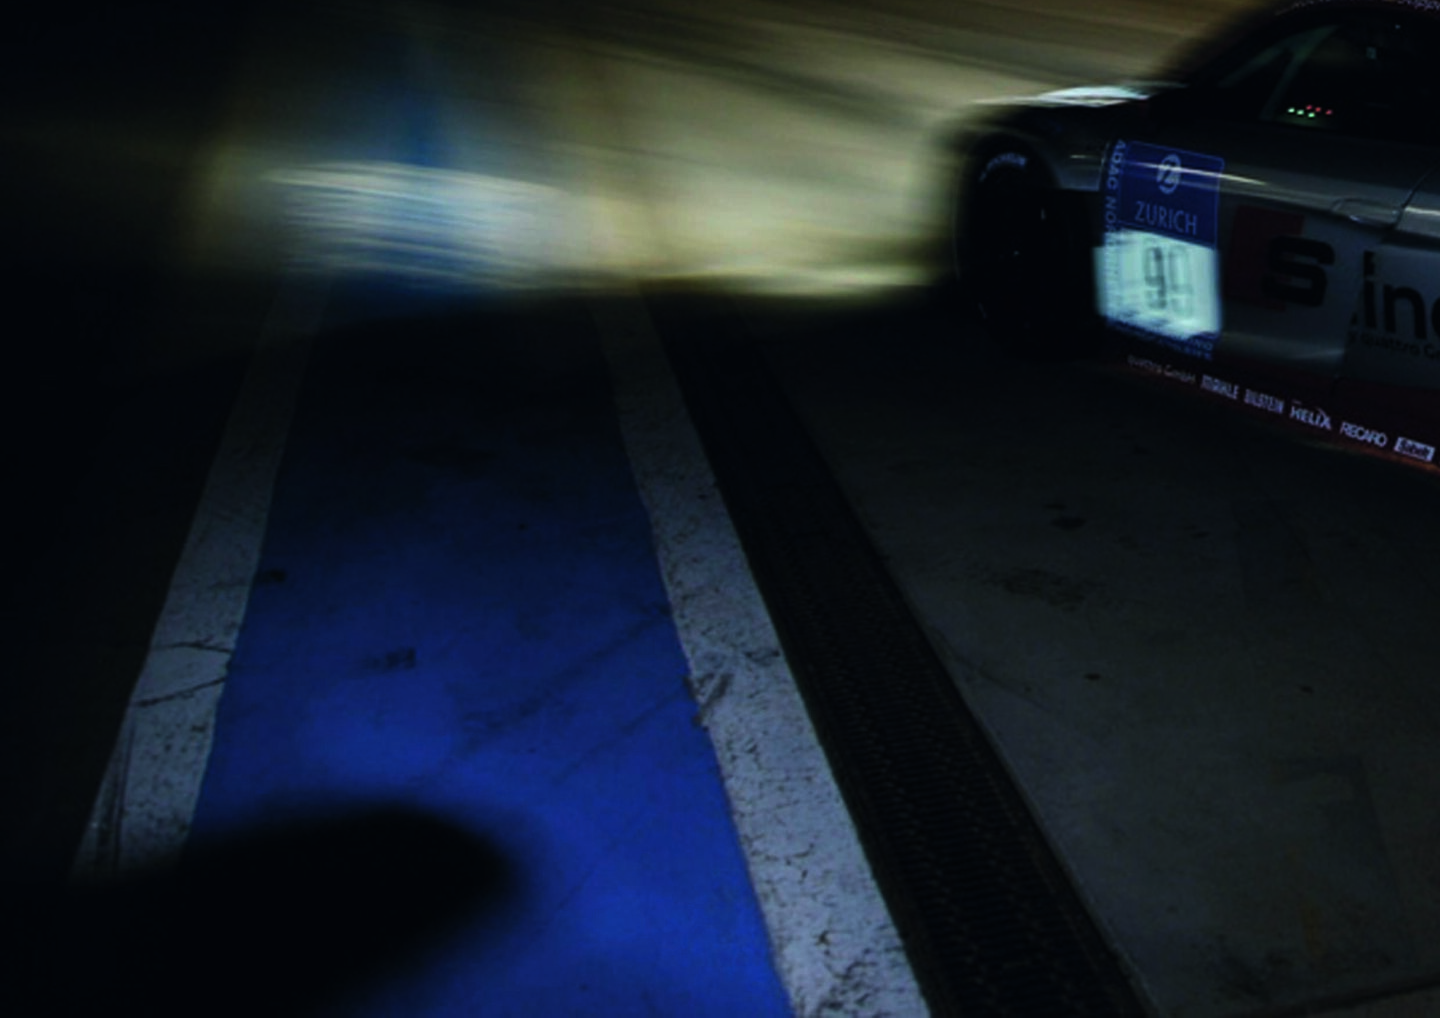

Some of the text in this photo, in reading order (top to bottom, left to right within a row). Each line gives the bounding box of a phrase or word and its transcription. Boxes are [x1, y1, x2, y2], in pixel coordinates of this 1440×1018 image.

[1106, 138, 1127, 191] ADAC
[1134, 200, 1198, 236] ZURICH
[1339, 420, 1388, 448] RECARO
